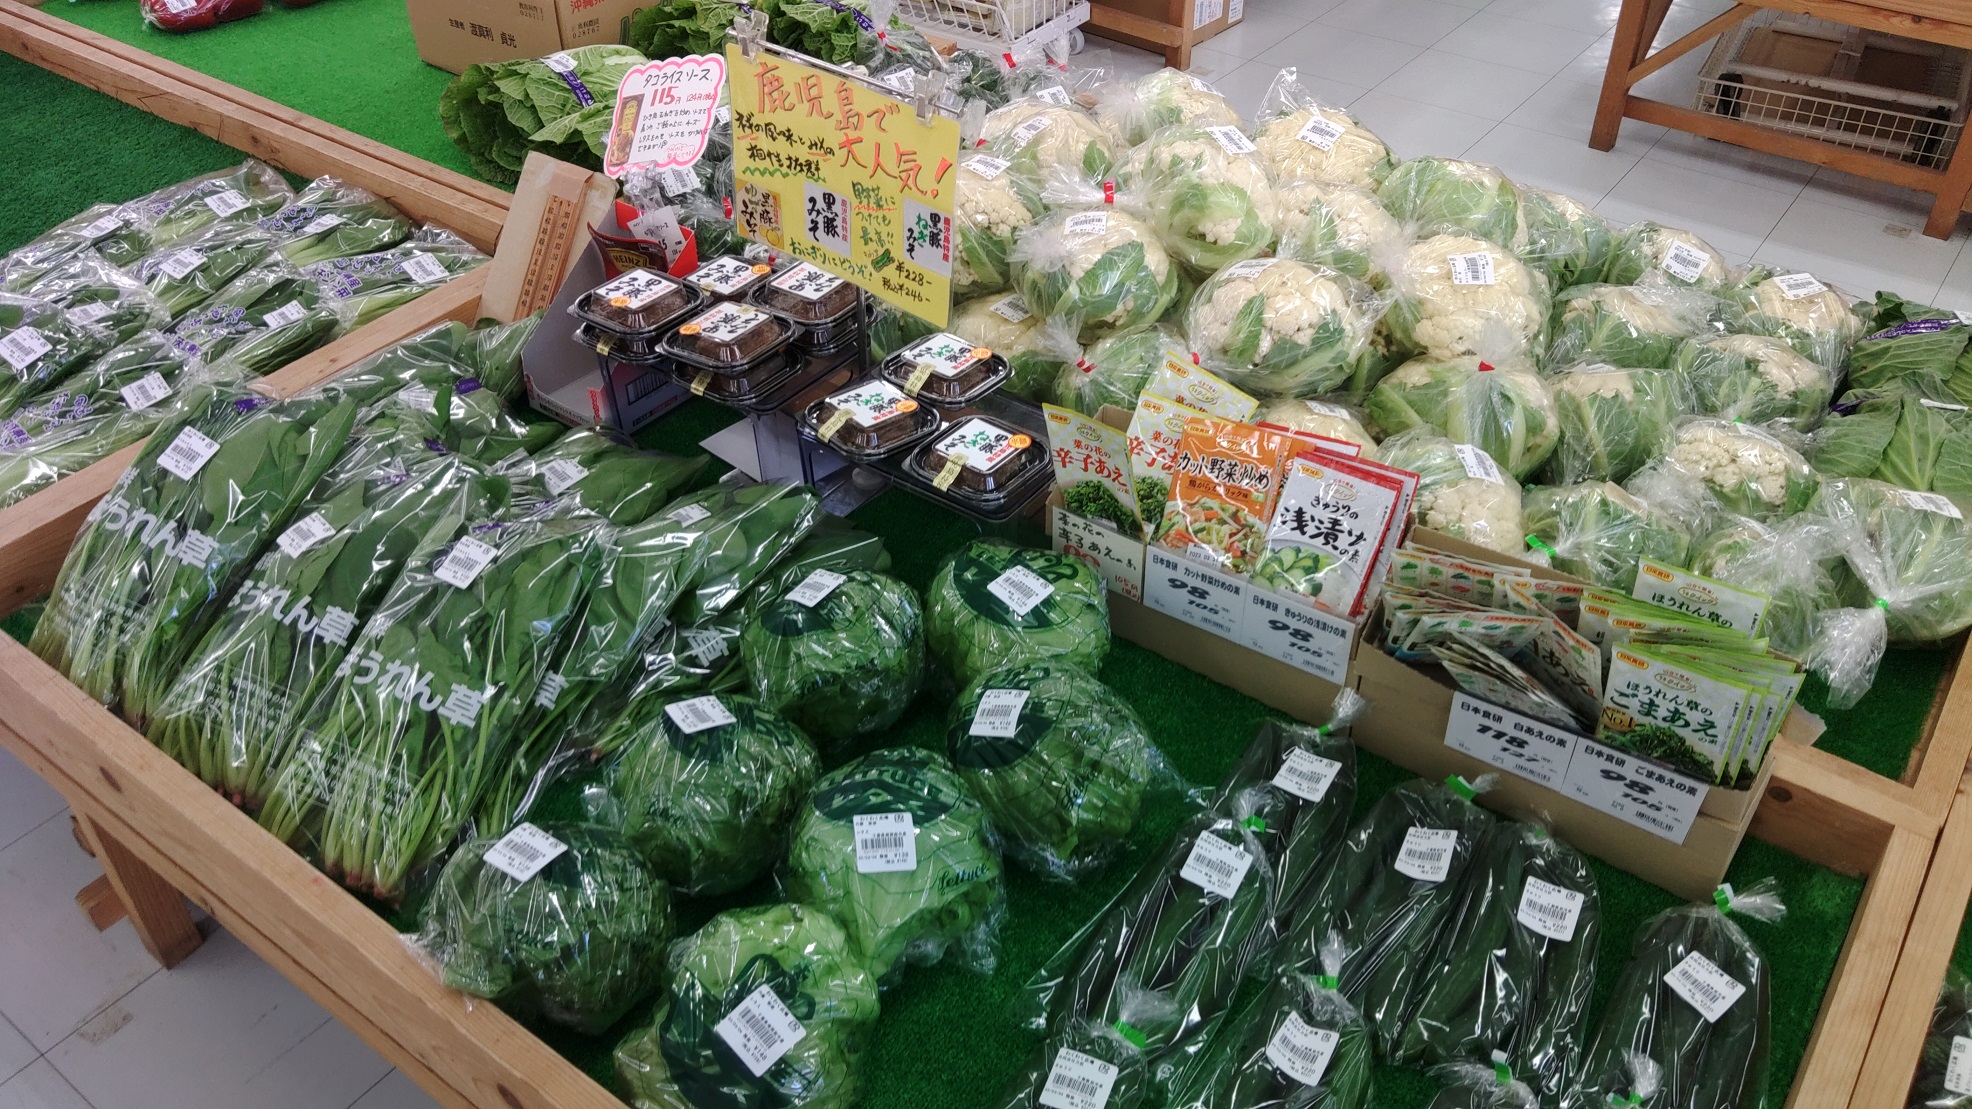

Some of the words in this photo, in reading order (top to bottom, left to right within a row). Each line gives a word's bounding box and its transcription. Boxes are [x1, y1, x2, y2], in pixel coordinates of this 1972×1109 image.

[643, 70, 683, 88] タコライス
[754, 61, 900, 133] 鹿児島で
[746, 142, 820, 177] 相性抜群
[838, 132, 953, 198] 大人気!
[851, 181, 896, 209] 野菜に
[807, 196, 823, 242] みそ
[822, 192, 840, 238] 黒豚
[856, 211, 892, 226] つけても
[916, 213, 930, 248] ねぎ
[929, 212, 942, 249] 黒豚
[612, 255, 641, 267] HEINZ
[906, 228, 918, 260] みそ
[1074, 439, 1111, 459] 菜の花の
[1053, 448, 1127, 487] 辛子あえ
[1177, 453, 1270, 490] カット野菜炒め
[1058, 511, 1105, 539] 菜の花の
[1311, 496, 1358, 520] きゅうりの
[1280, 506, 1367, 551] 浅漬け
[1152, 554, 1177, 570] 日本食研
[1184, 567, 1240, 595] カット野菜炒めの素
[1168, 578, 1209, 599] 98
[1252, 595, 1278, 611] 日本食研
[1284, 608, 1346, 638] きゅうりの浅漬けの素
[1651, 593, 1733, 628] ほうれん草の
[1268, 619, 1312, 642] 98
[1610, 688, 1718, 738] ごまあえ
[1626, 681, 1713, 716] ほうれん草の
[1461, 701, 1502, 723] 日本食研
[1513, 722, 1566, 747] 白あえの素
[1602, 708, 1633, 728] No.1
[1477, 724, 1528, 748] 118
[1584, 745, 1625, 766] 日本食研
[1635, 766, 1697, 795] ごまあえの素
[1600, 769, 1653, 794] 98
